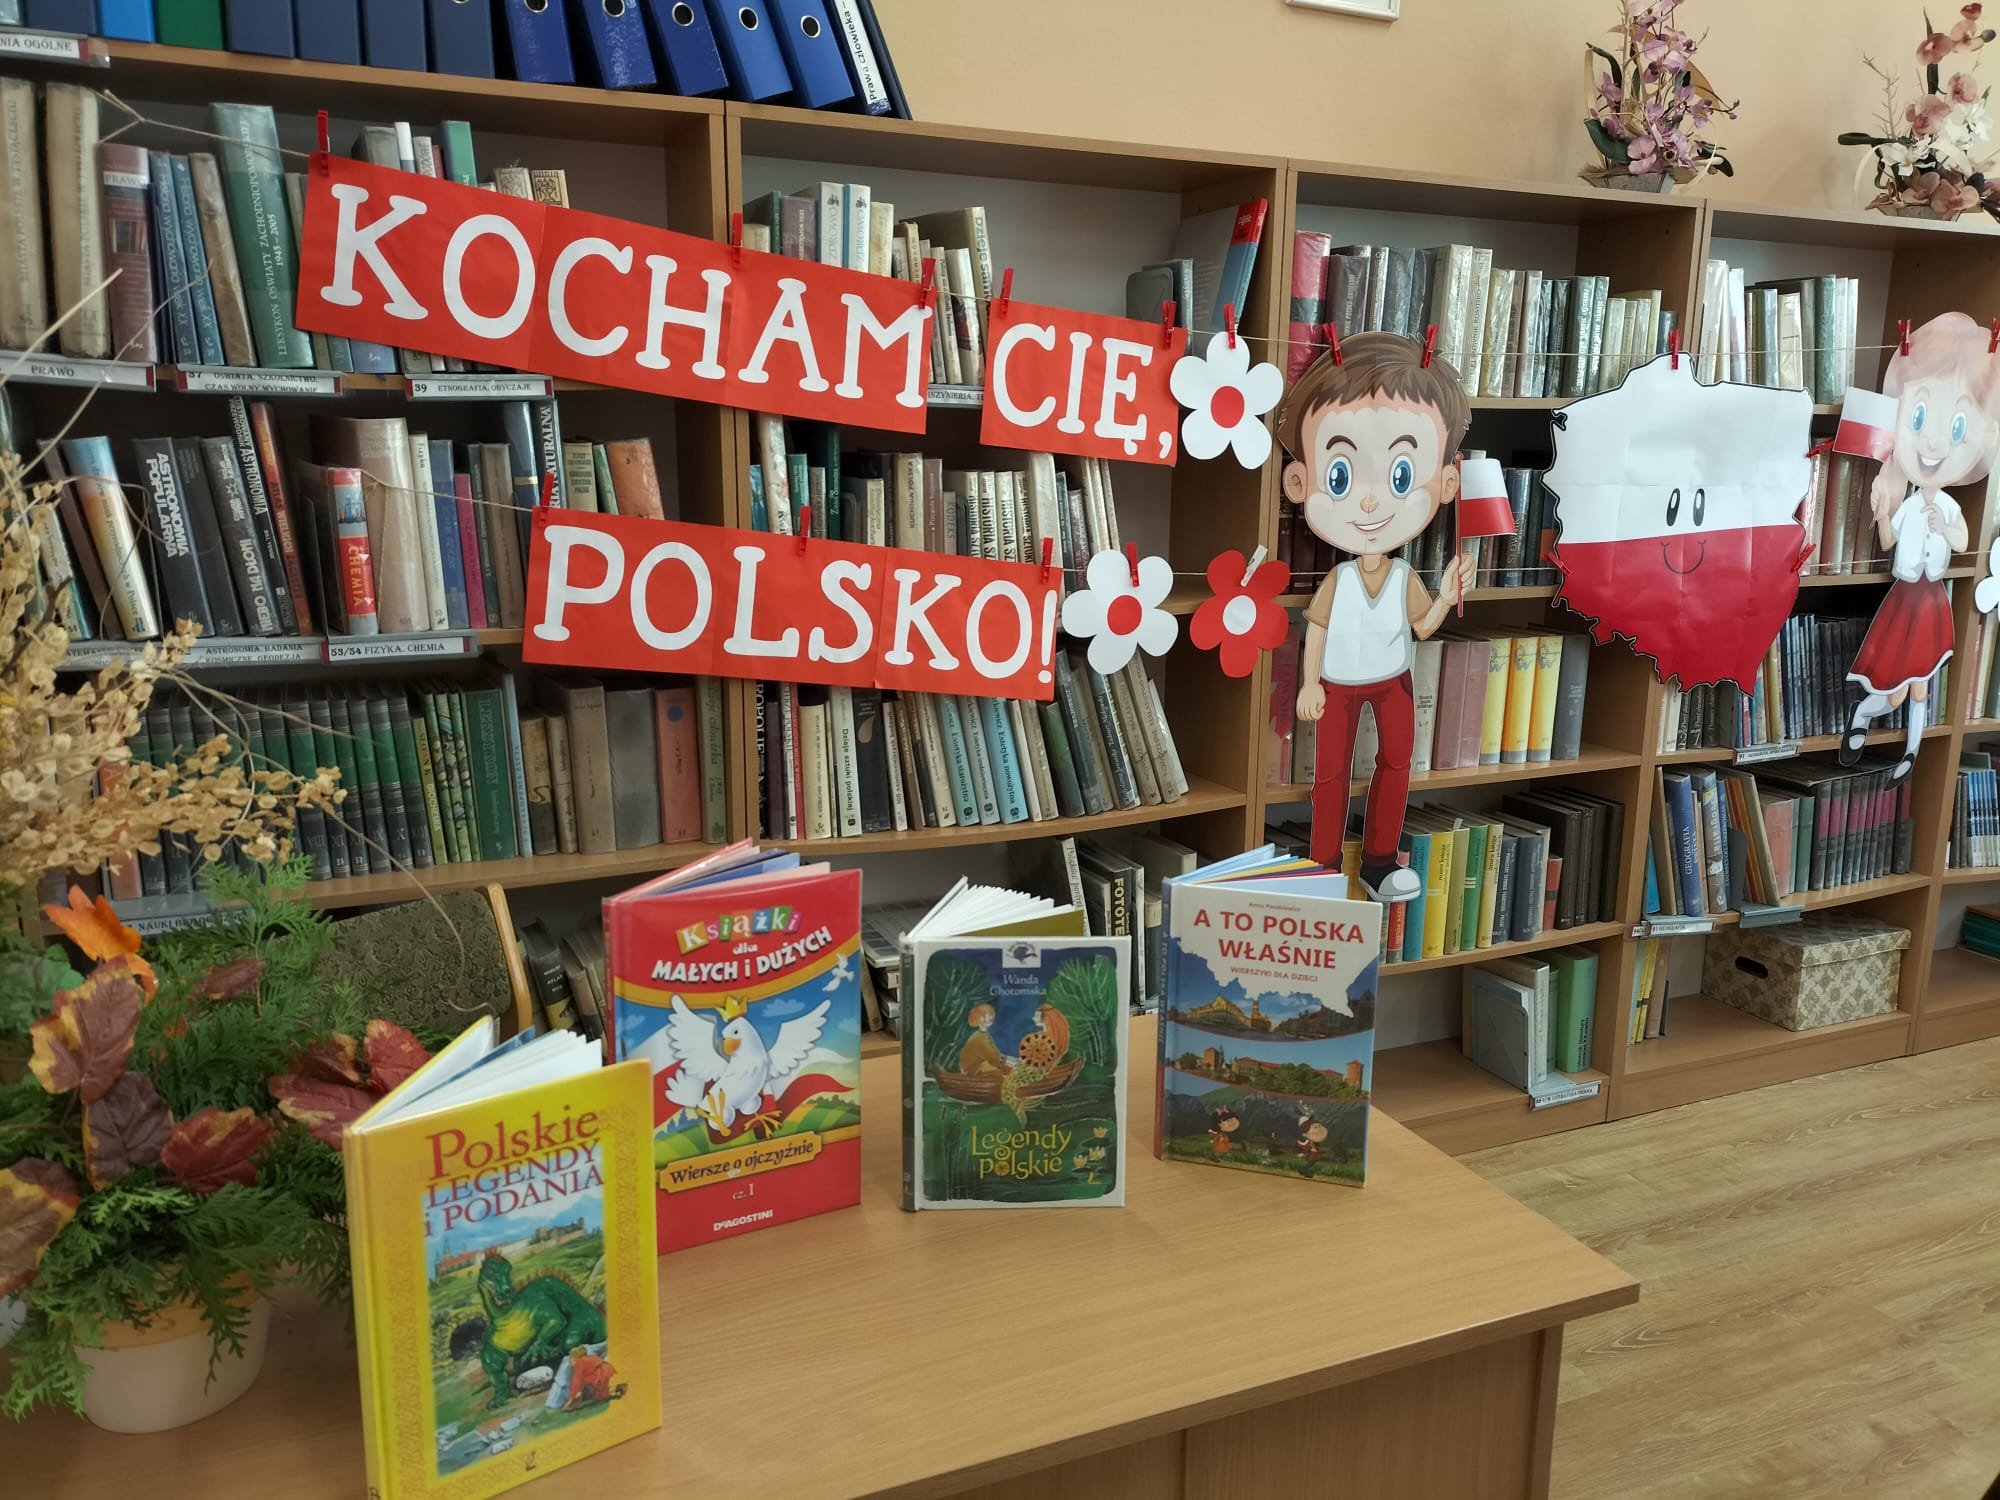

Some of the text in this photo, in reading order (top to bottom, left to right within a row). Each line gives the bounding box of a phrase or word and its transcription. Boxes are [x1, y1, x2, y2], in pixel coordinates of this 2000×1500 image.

[23, 38, 72, 52] OGÓLNE
[844, 11, 878, 100] Prawa człowieka
[267, 212, 284, 266] 1945 2005
[973, 216, 988, 262] Dzieje
[320, 183, 932, 408] KOCHAM
[269, 303, 288, 356] LEKSYKON
[31, 366, 75, 377] PRAWO
[414, 383, 428, 392] 39
[491, 383, 532, 391] OBYCZAJE
[992, 322, 1173, 459] CIĘ,
[540, 407, 559, 484] ATURALNA
[239, 446, 269, 516] ASTRONOMIA
[146, 458, 178, 559] POPULARNA
[157, 452, 190, 557] ASTRONOMIA
[907, 491, 915, 528] KUCHNIA
[980, 497, 996, 544] HISTORIA
[1000, 499, 1015, 545] HISTORIA
[348, 545, 362, 607] CHEMIA
[125, 589, 140, 616] Polsce
[254, 595, 274, 631] NIEBO
[534, 524, 1057, 684] POLSKO!
[331, 646, 362, 657] 53/54
[407, 642, 445, 652] CHEMIA
[478, 700, 499, 785] LEKSYKON
[948, 731, 963, 764] Estetyka
[971, 731, 983, 757] Estetyka
[996, 730, 1010, 763] Estetyka
[841, 727, 854, 810] Dzieje sztuki polskiej
[1001, 764, 1017, 804] nowożytna
[1682, 826, 1693, 874] GEOGRAFIA
[138, 921, 173, 931] NAUKI
[681, 907, 799, 950] Książki
[1114, 877, 1125, 936] FOTOTE
[1193, 909, 1365, 944] A TO POLSKA
[651, 926, 832, 985] MAŁYCH i DUŻYCH
[733, 941, 758, 955] dla
[1218, 938, 1336, 969] WŁAŚNIE
[1002, 974, 1039, 985] Wanda
[1159, 957, 1167, 995] POLSKA
[1230, 966, 1318, 983] WIERSZYKI DLA DZIECI
[426, 1105, 599, 1181] Polskie
[669, 1140, 815, 1185] Wiersze o ojczyźnie
[971, 1124, 1072, 1160] Legendy
[427, 1138, 601, 1209] LEGENDY
[424, 1165, 605, 1238] i PODANIA
